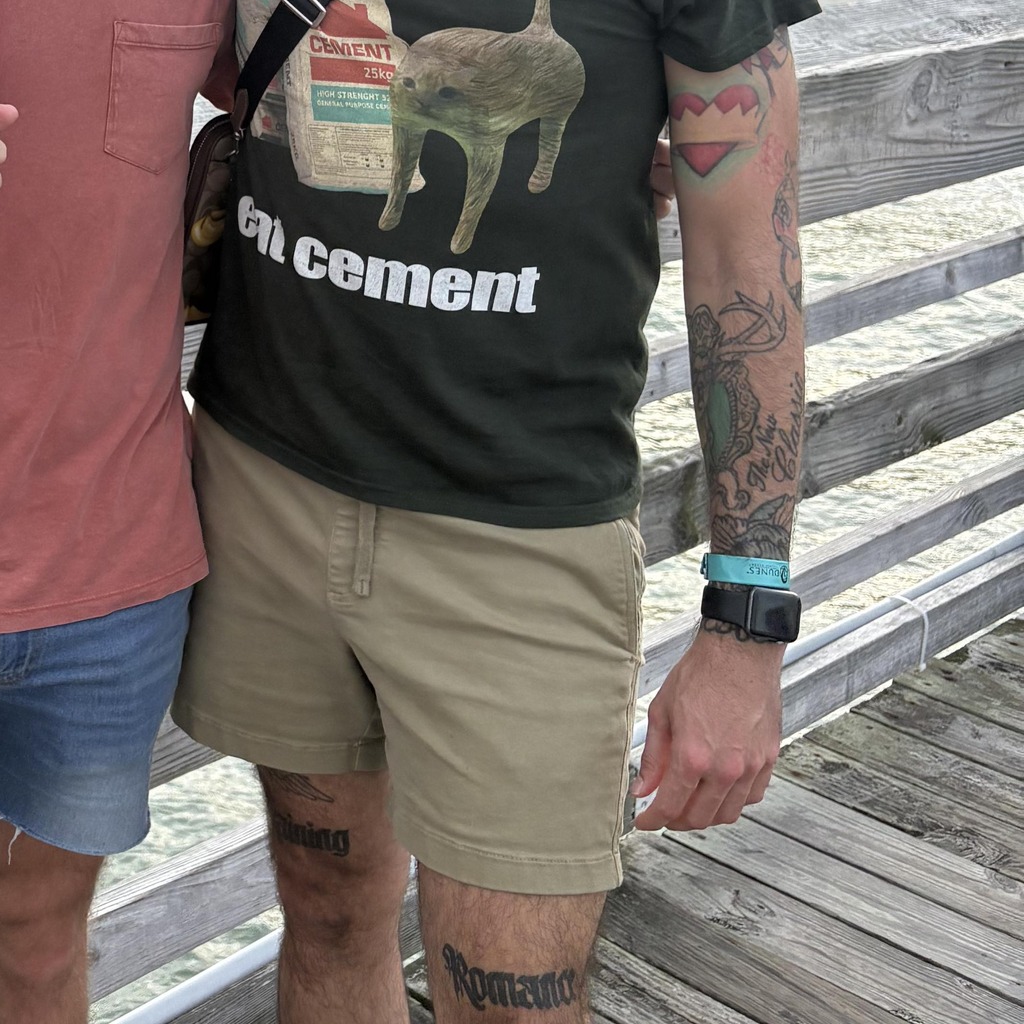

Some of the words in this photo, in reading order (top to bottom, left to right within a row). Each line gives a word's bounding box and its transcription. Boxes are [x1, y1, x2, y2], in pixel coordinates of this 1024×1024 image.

[309, 34, 392, 61] CEMENT
[363, 67, 395, 83] 25kg
[317, 90, 335, 98] HIGH
[337, 91, 379, 101] STRENGHT
[317, 99, 344, 108] GENERAL
[345, 101, 375, 110] PURPOSE
[292, 235, 541, 314] cement
